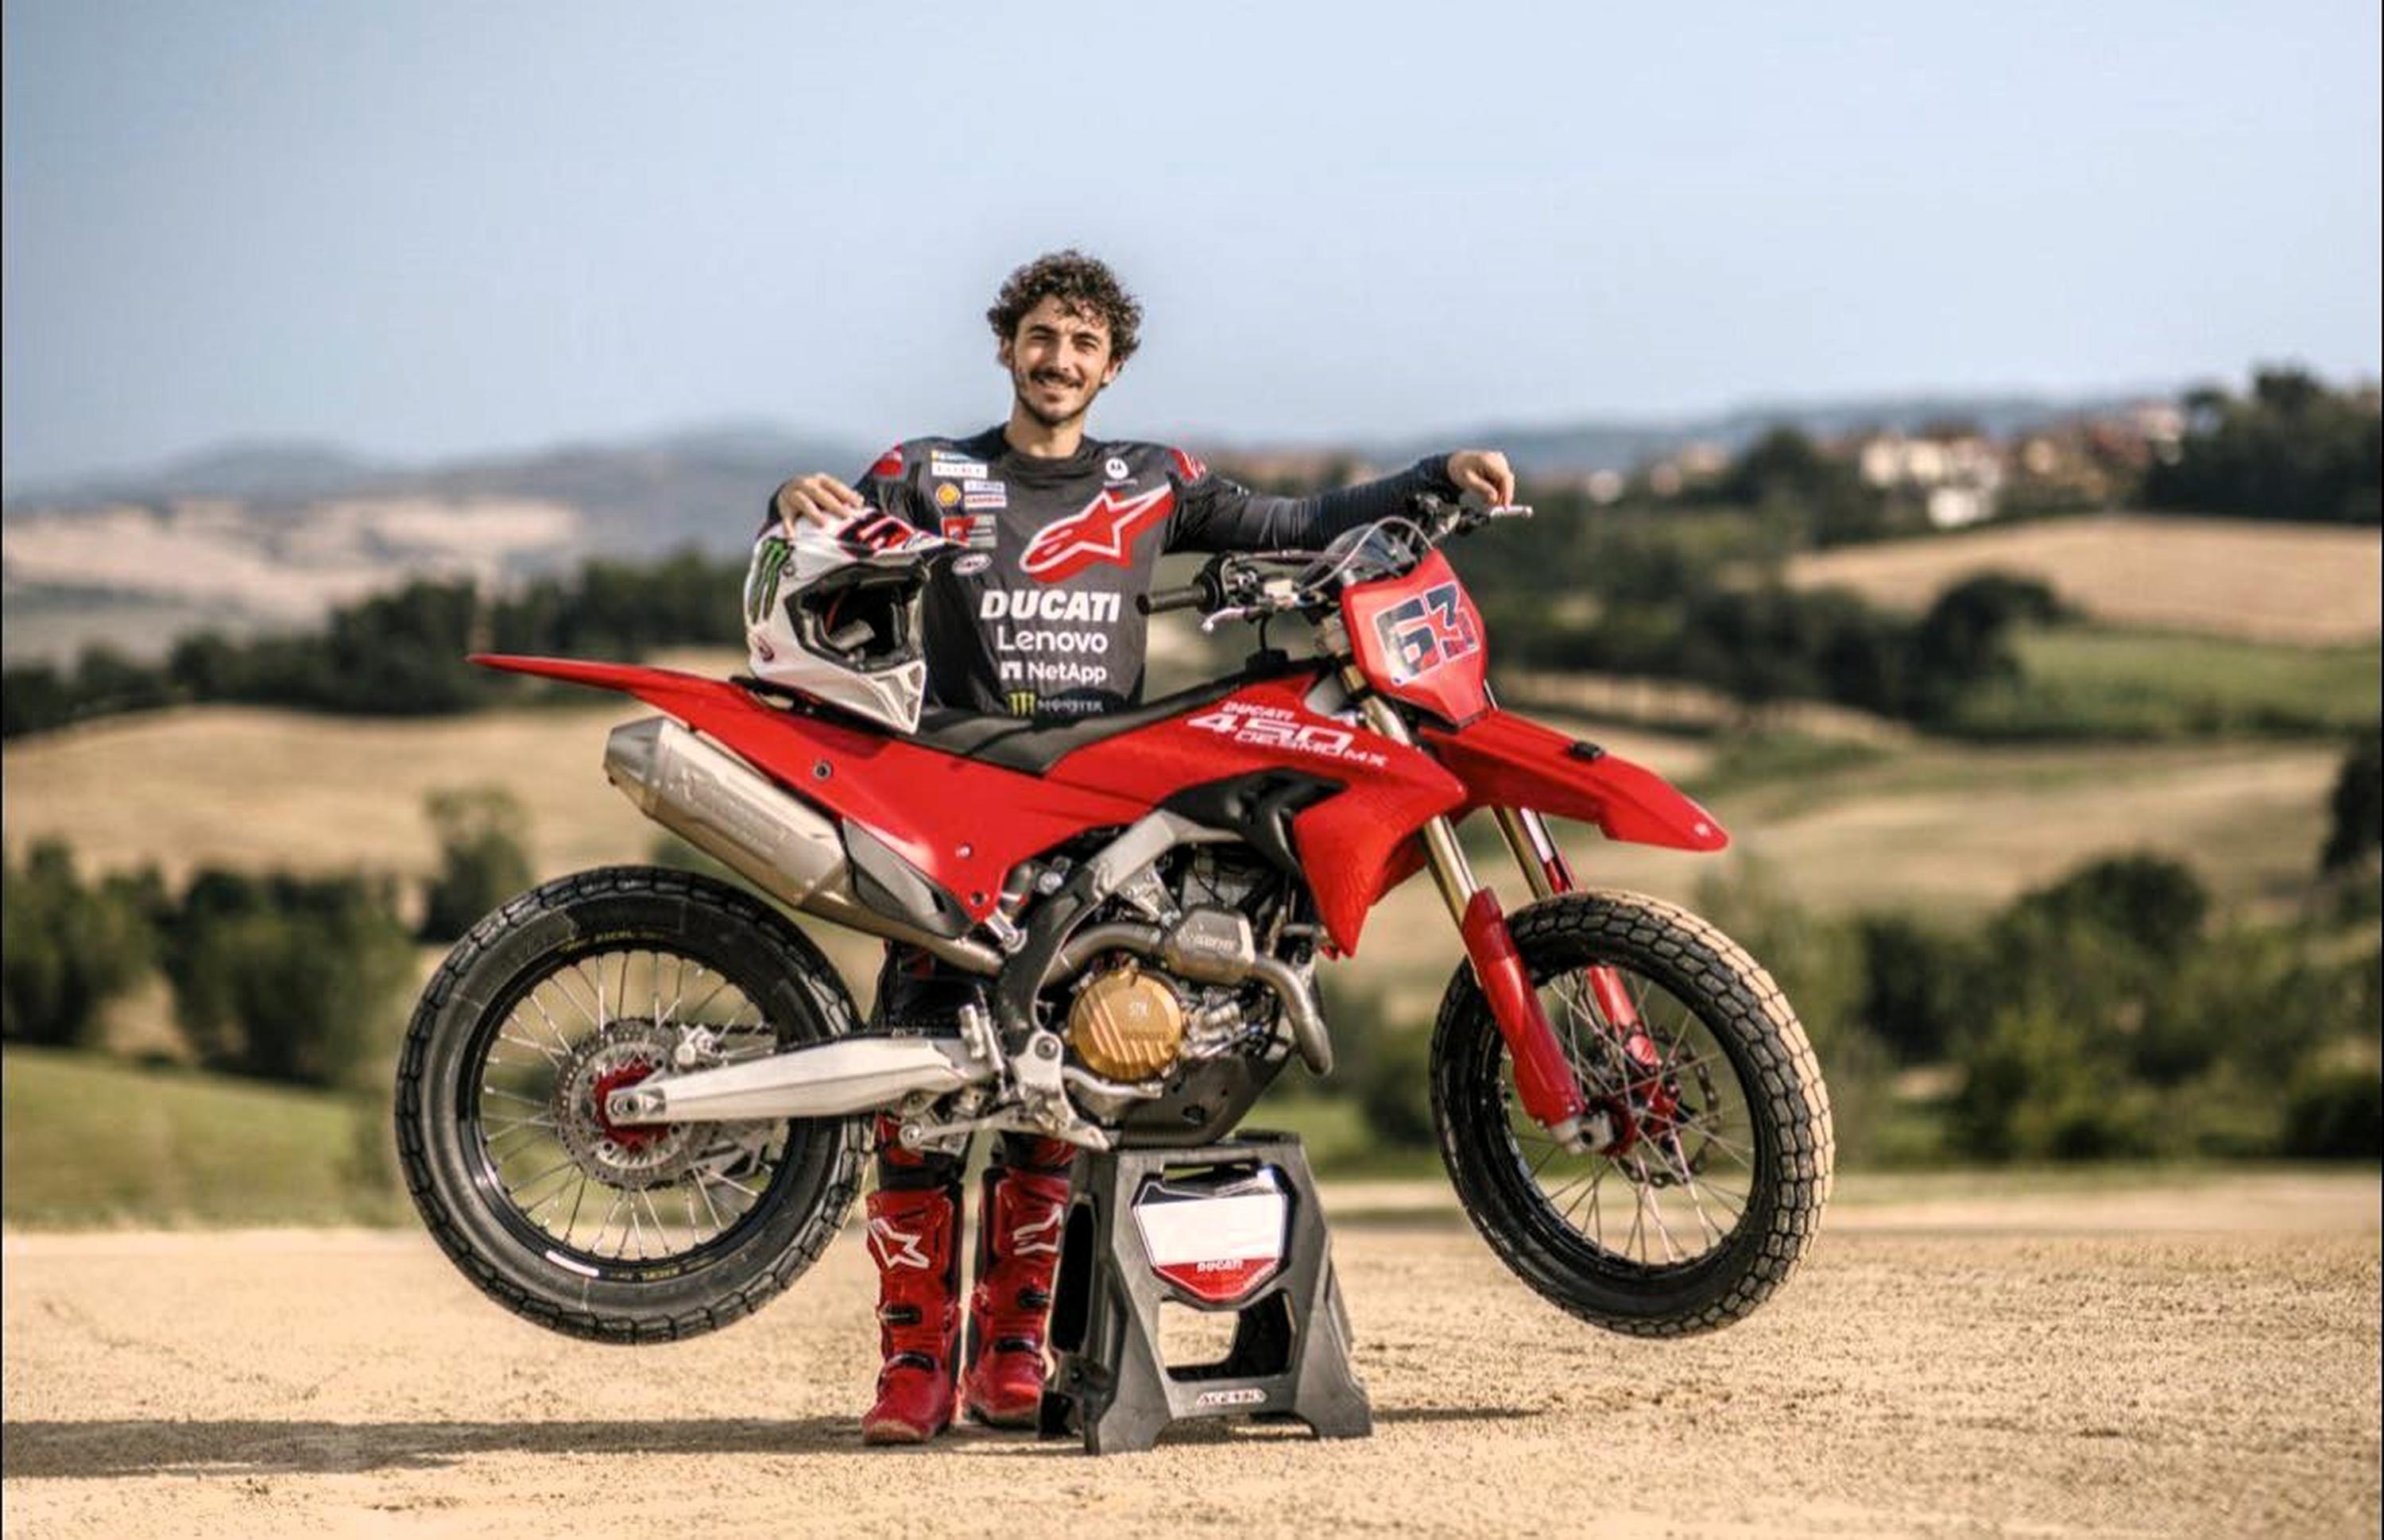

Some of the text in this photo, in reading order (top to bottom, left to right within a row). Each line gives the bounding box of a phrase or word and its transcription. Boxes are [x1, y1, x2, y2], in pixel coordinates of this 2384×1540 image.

[979, 589, 1121, 622] DUCATI
[997, 625, 1108, 654] Lenovo
[1373, 581, 1480, 687] 63
[1028, 661, 1107, 684] NetApp
[1037, 698, 1103, 713] MONSTER
[1221, 701, 1295, 721] DUCATI
[1186, 713, 1354, 751] 450
[1197, 1259, 1244, 1274] DUCATI
